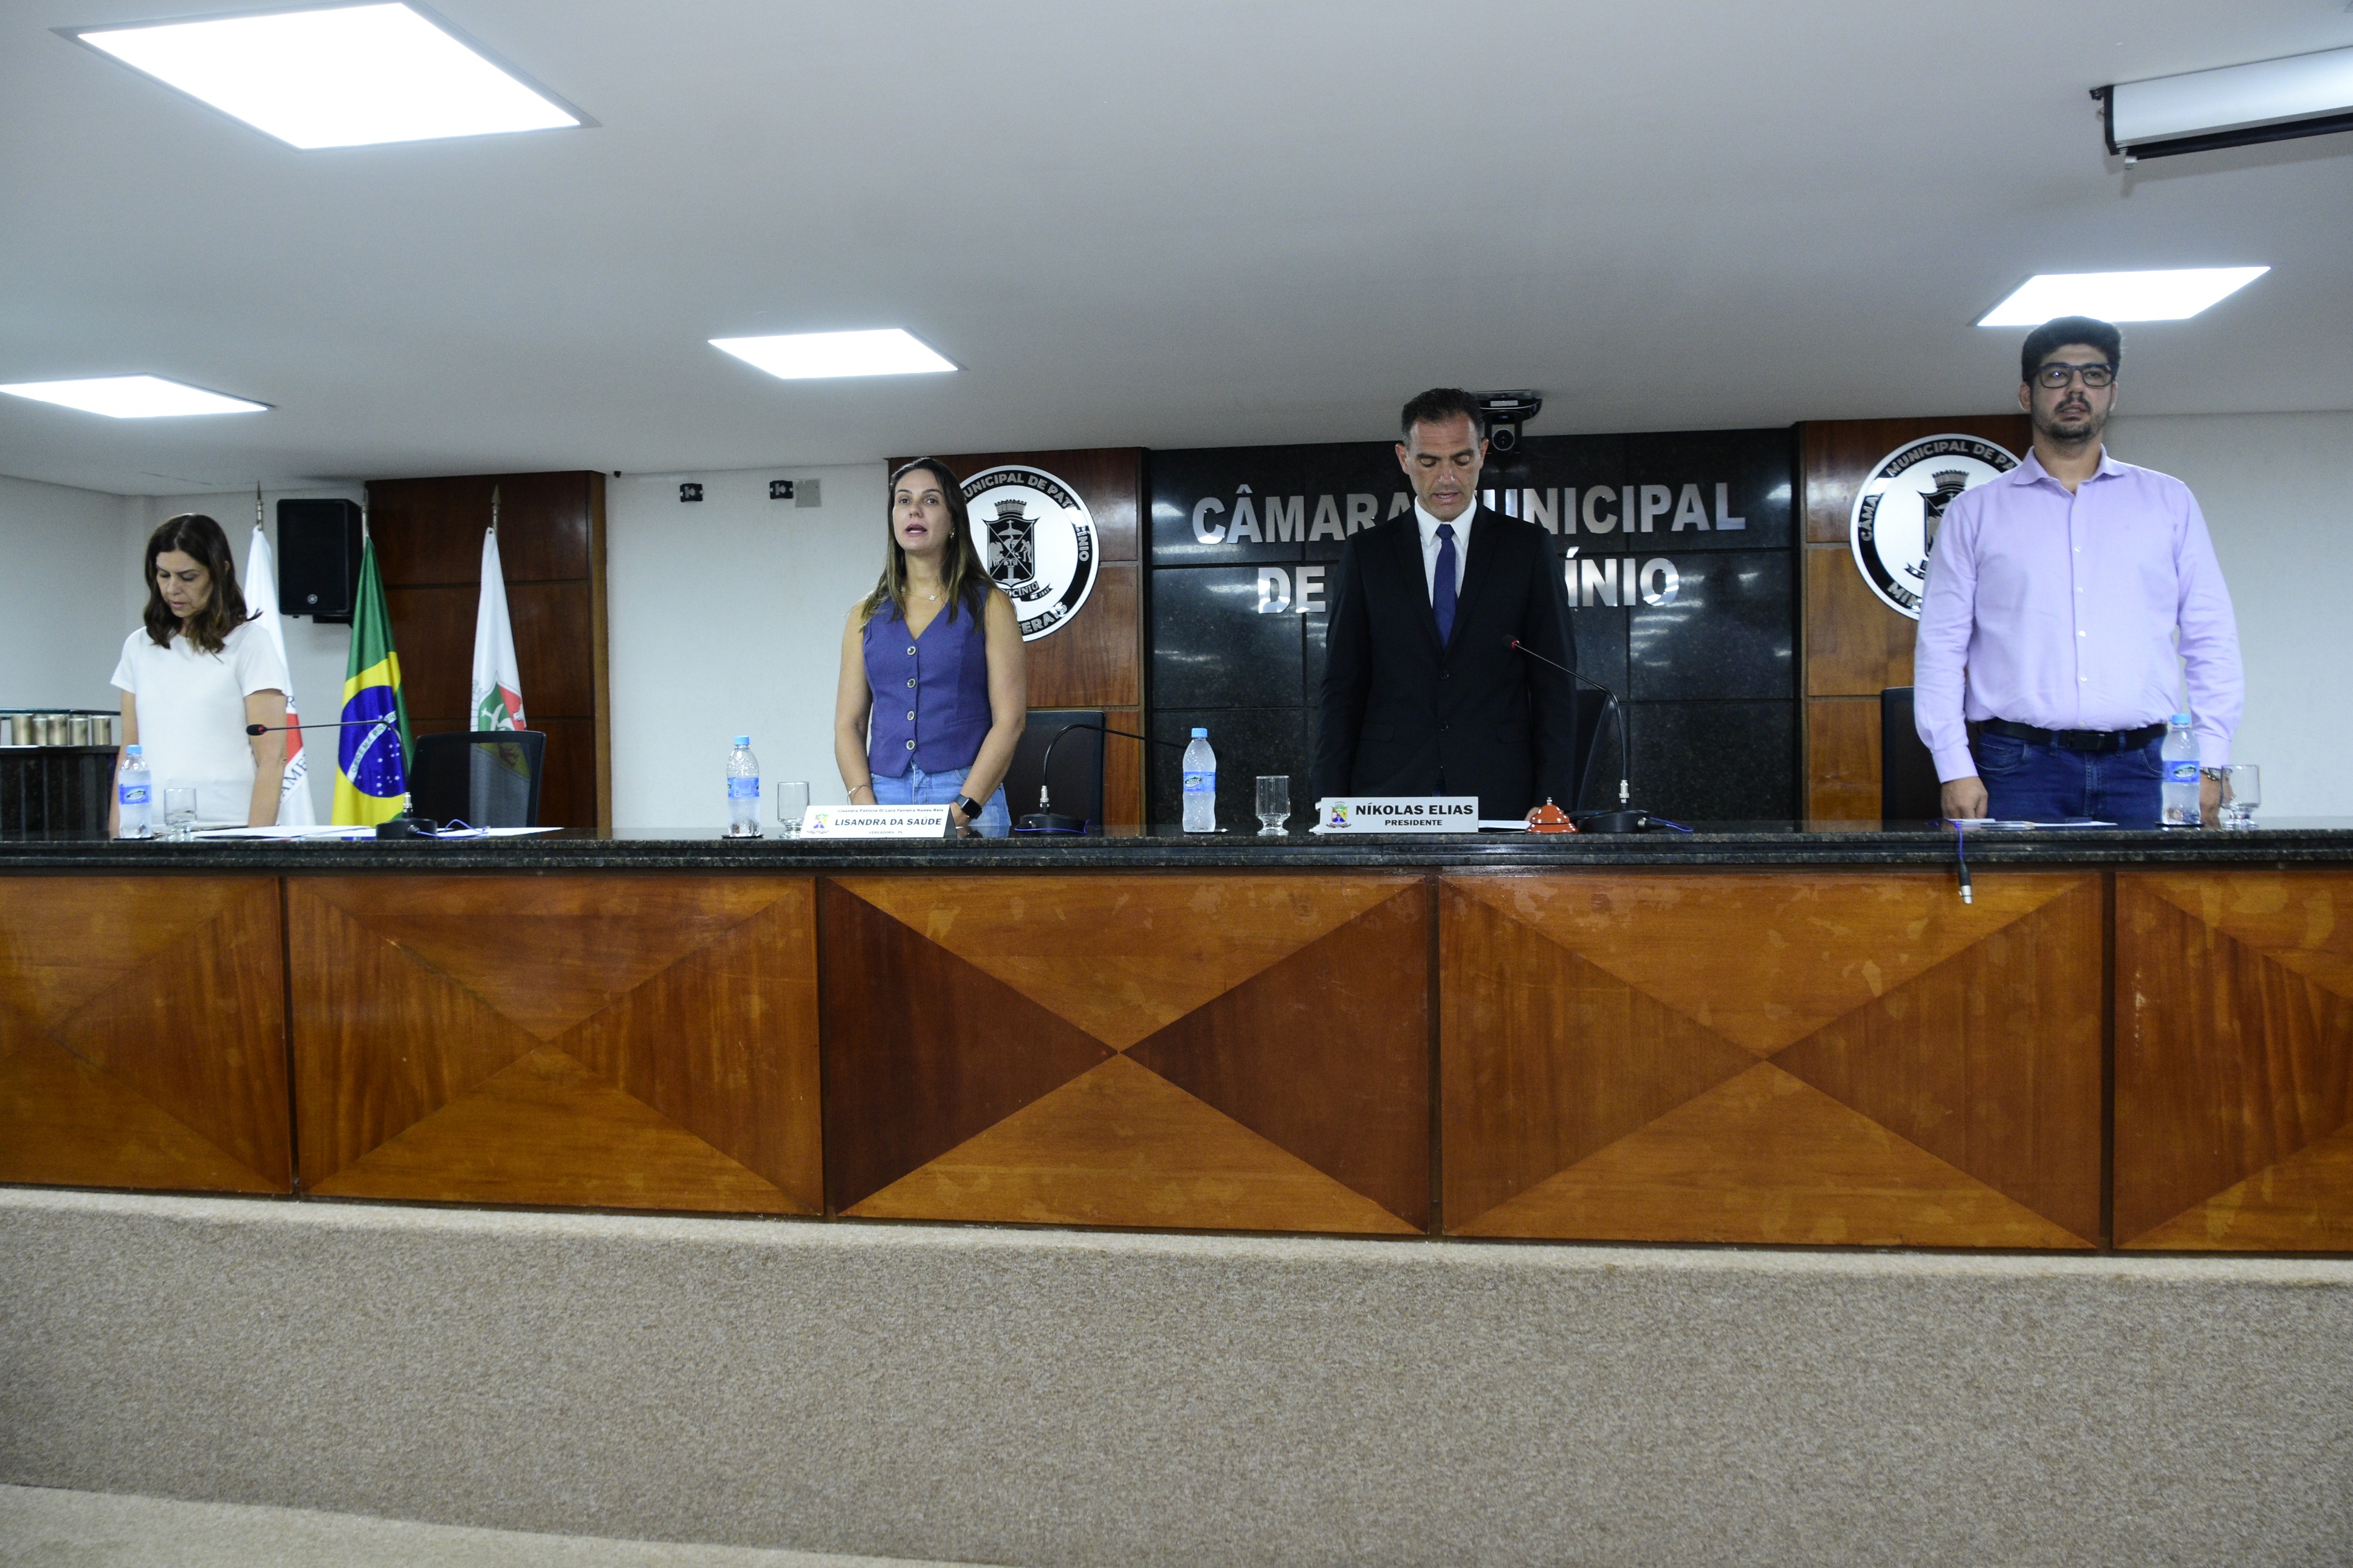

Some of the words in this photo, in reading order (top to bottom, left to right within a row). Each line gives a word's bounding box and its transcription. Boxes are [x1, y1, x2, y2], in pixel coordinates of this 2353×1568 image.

[1483, 482, 1747, 535] UNICIPAL
[1858, 496, 1880, 542] CÂMA
[1886, 441, 1968, 478] MUNICIPAL
[1972, 443, 1996, 460] DE
[963, 473, 1025, 498] UNICIPAL
[1027, 475, 1048, 491] DE
[1046, 484, 1091, 561] PATÍNIO
[1258, 566, 1327, 614] DE
[1022, 601, 1068, 634] ERAIS
[907, 817, 942, 826] SAÚDE
[1356, 802, 1424, 815] NÍKOLAS
[1429, 805, 1474, 815] ELIAS
